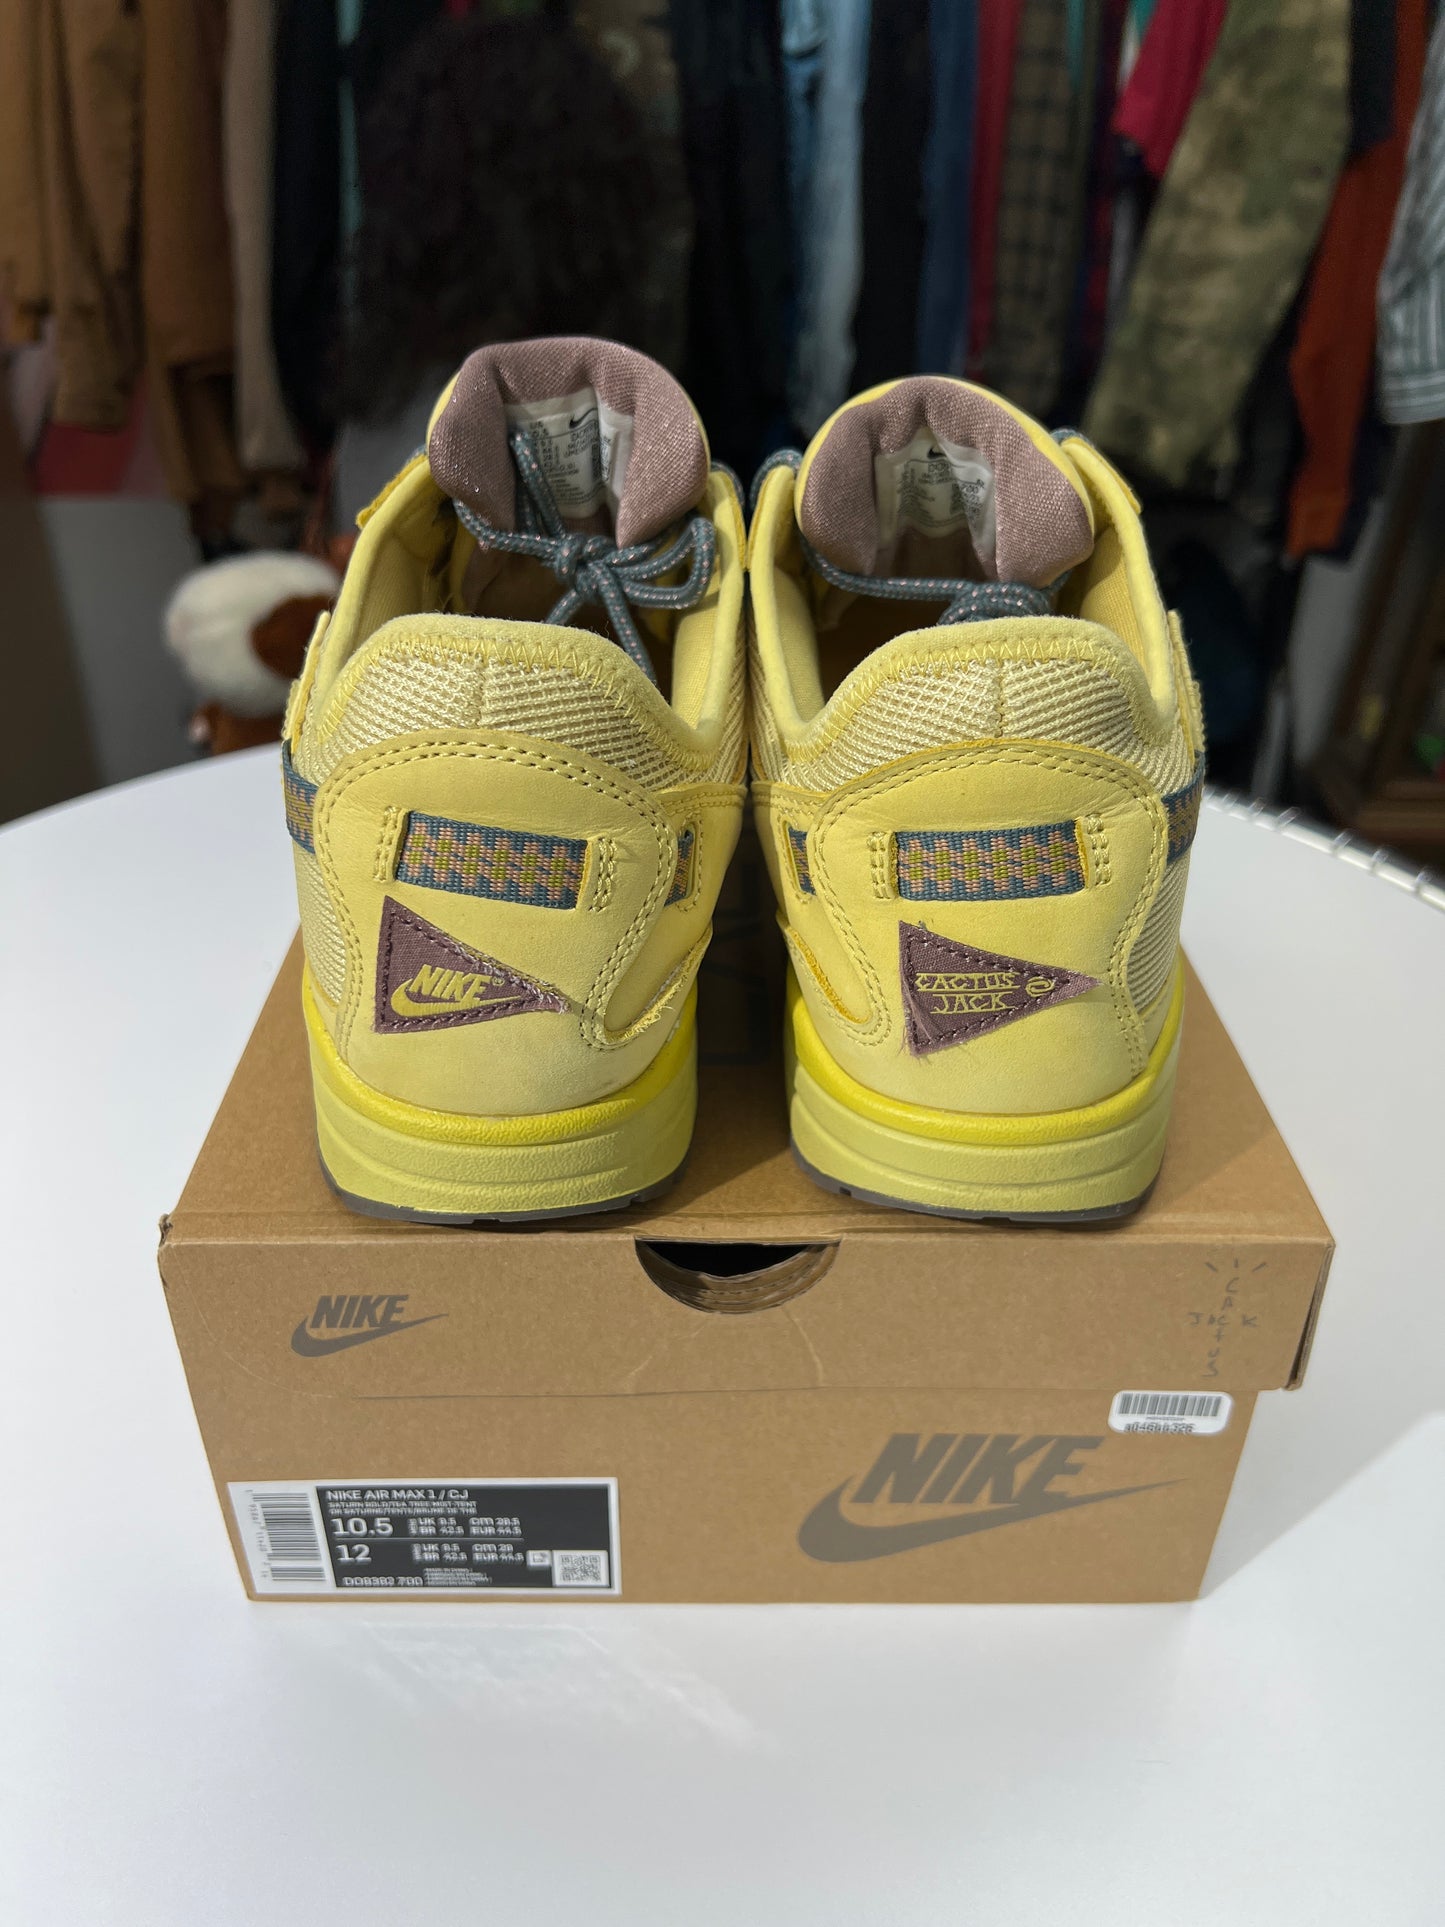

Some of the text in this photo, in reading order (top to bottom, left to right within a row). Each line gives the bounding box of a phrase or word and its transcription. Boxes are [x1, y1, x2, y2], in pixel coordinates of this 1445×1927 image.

[408, 964, 492, 1003] NIKE
[914, 972, 1021, 992] CACTUS
[930, 991, 1017, 1014] JACK
[310, 1294, 410, 1329] NIKE
[849, 1432, 1106, 1505] NIKE
[326, 1489, 361, 1501] NIKE
[363, 1489, 390, 1500] AIR
[391, 1489, 425, 1500] MAX
[427, 1489, 437, 1500] 1
[447, 1489, 470, 1500] CJ
[331, 1517, 394, 1538] 10.5
[418, 1517, 436, 1526] UK
[470, 1526, 496, 1536] EUR
[335, 1543, 373, 1564] 12
[422, 1543, 440, 1552] UK
[473, 1552, 499, 1562] EUR
